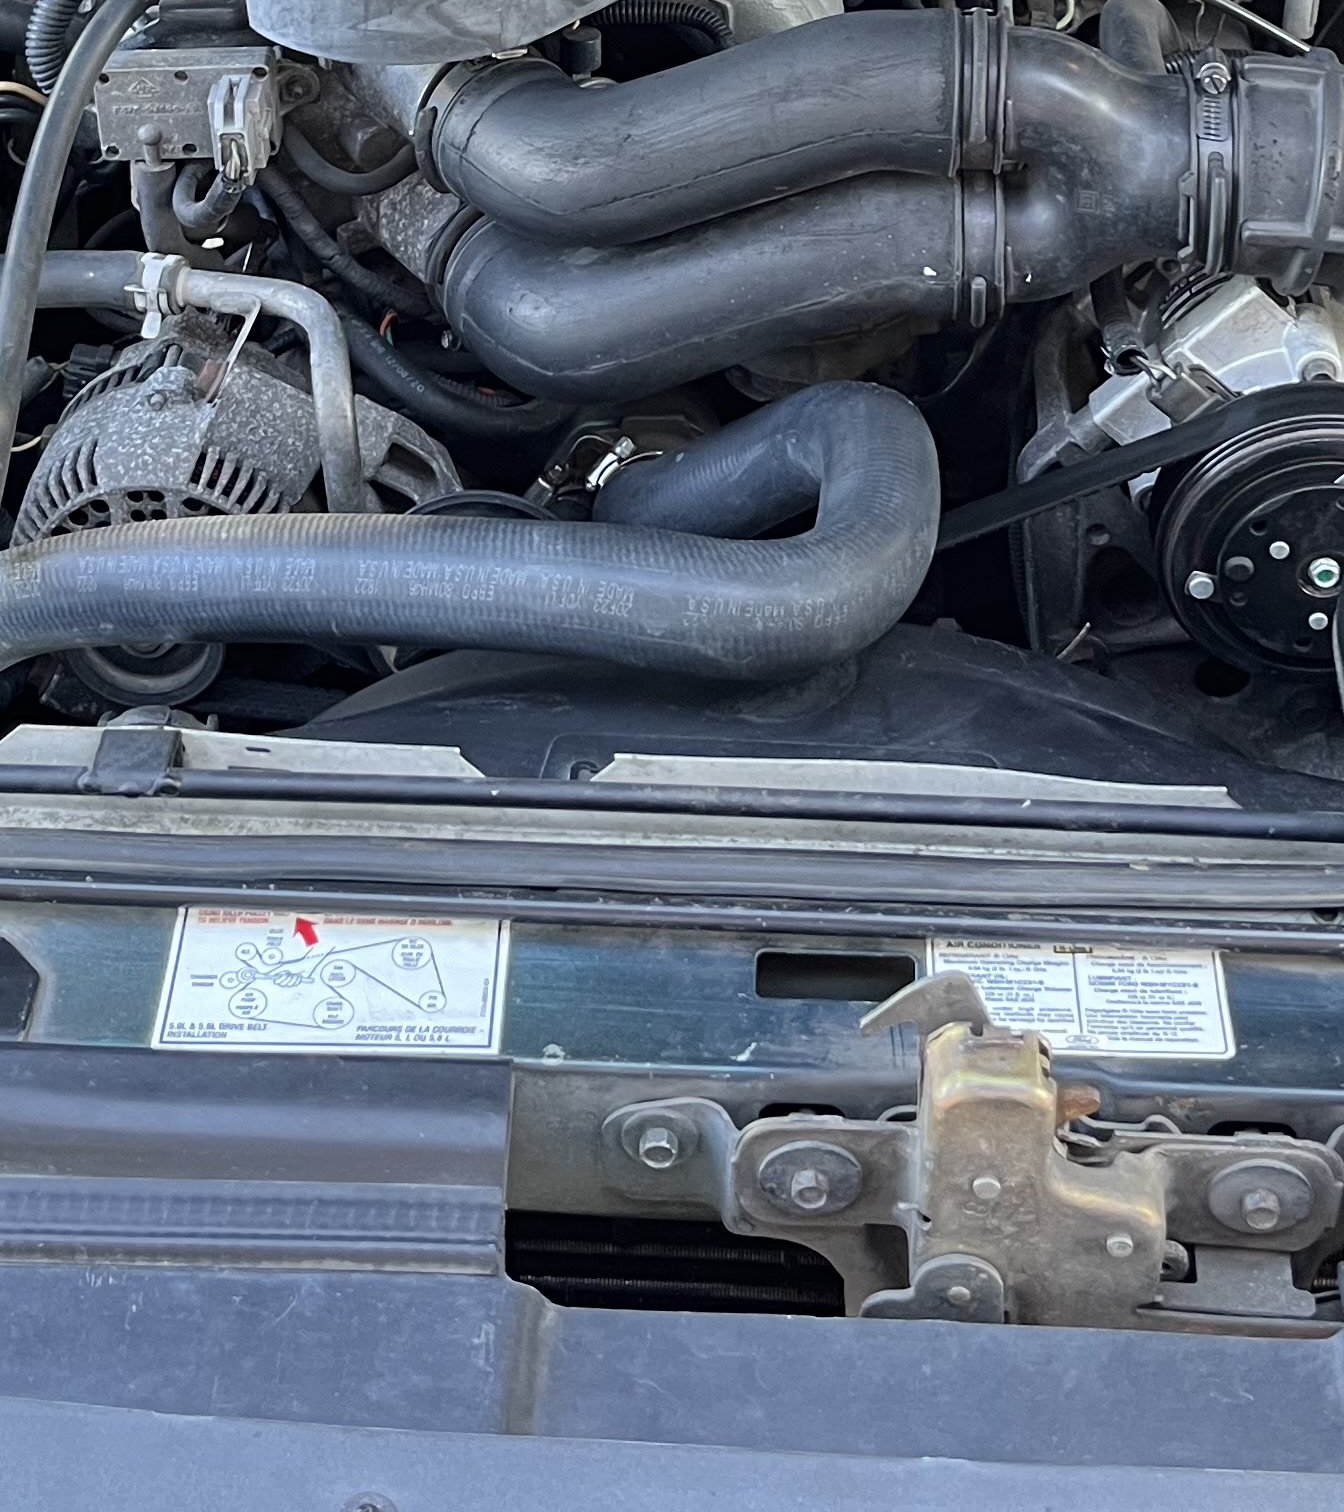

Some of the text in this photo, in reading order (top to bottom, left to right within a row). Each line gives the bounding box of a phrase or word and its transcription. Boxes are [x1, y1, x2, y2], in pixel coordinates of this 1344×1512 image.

[403, 561, 440, 580] MADE
[476, 566, 490, 584] IN
[490, 567, 529, 586] MADE
[247, 1023, 268, 1031] BELT
